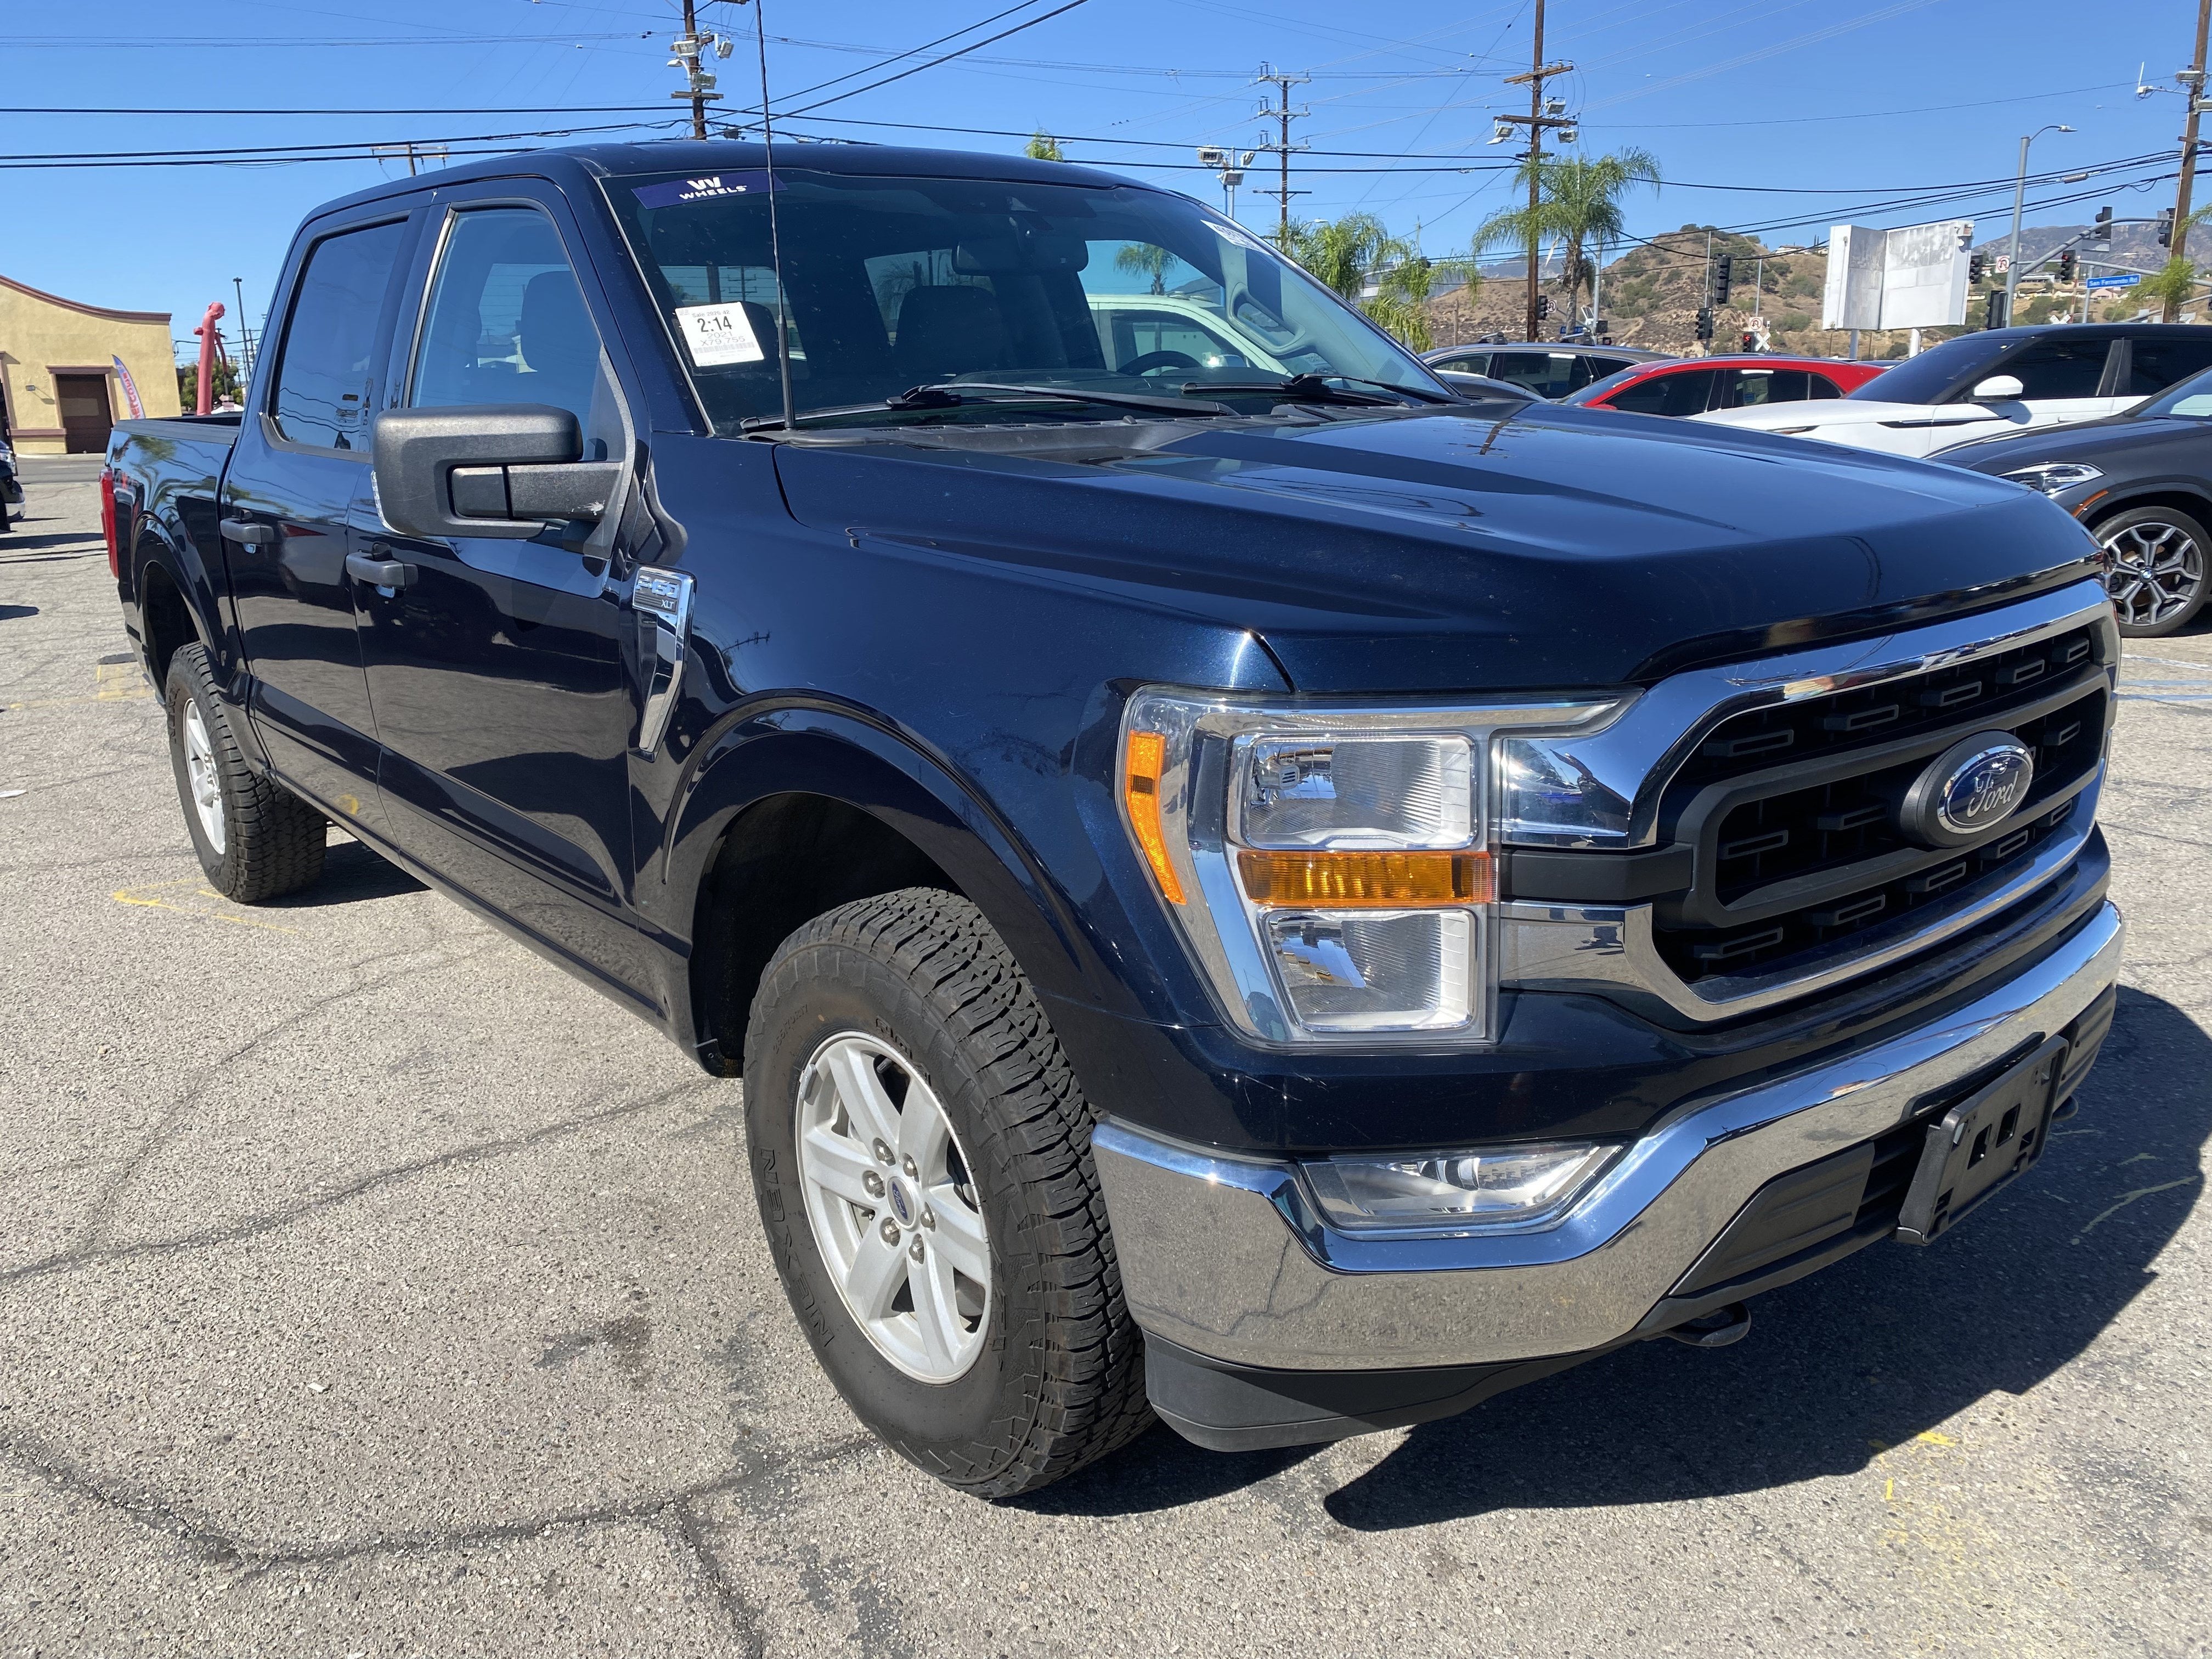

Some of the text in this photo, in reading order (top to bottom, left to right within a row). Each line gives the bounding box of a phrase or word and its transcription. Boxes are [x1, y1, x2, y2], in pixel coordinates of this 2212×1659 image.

[679, 185, 747, 199] WHEELS
[697, 316, 732, 332] 2:14
[661, 599, 675, 610] XLT
[1966, 757, 2019, 817] Ford
[893, 1189, 906, 1215] Ford
[760, 1148, 835, 1348] NEXEN
